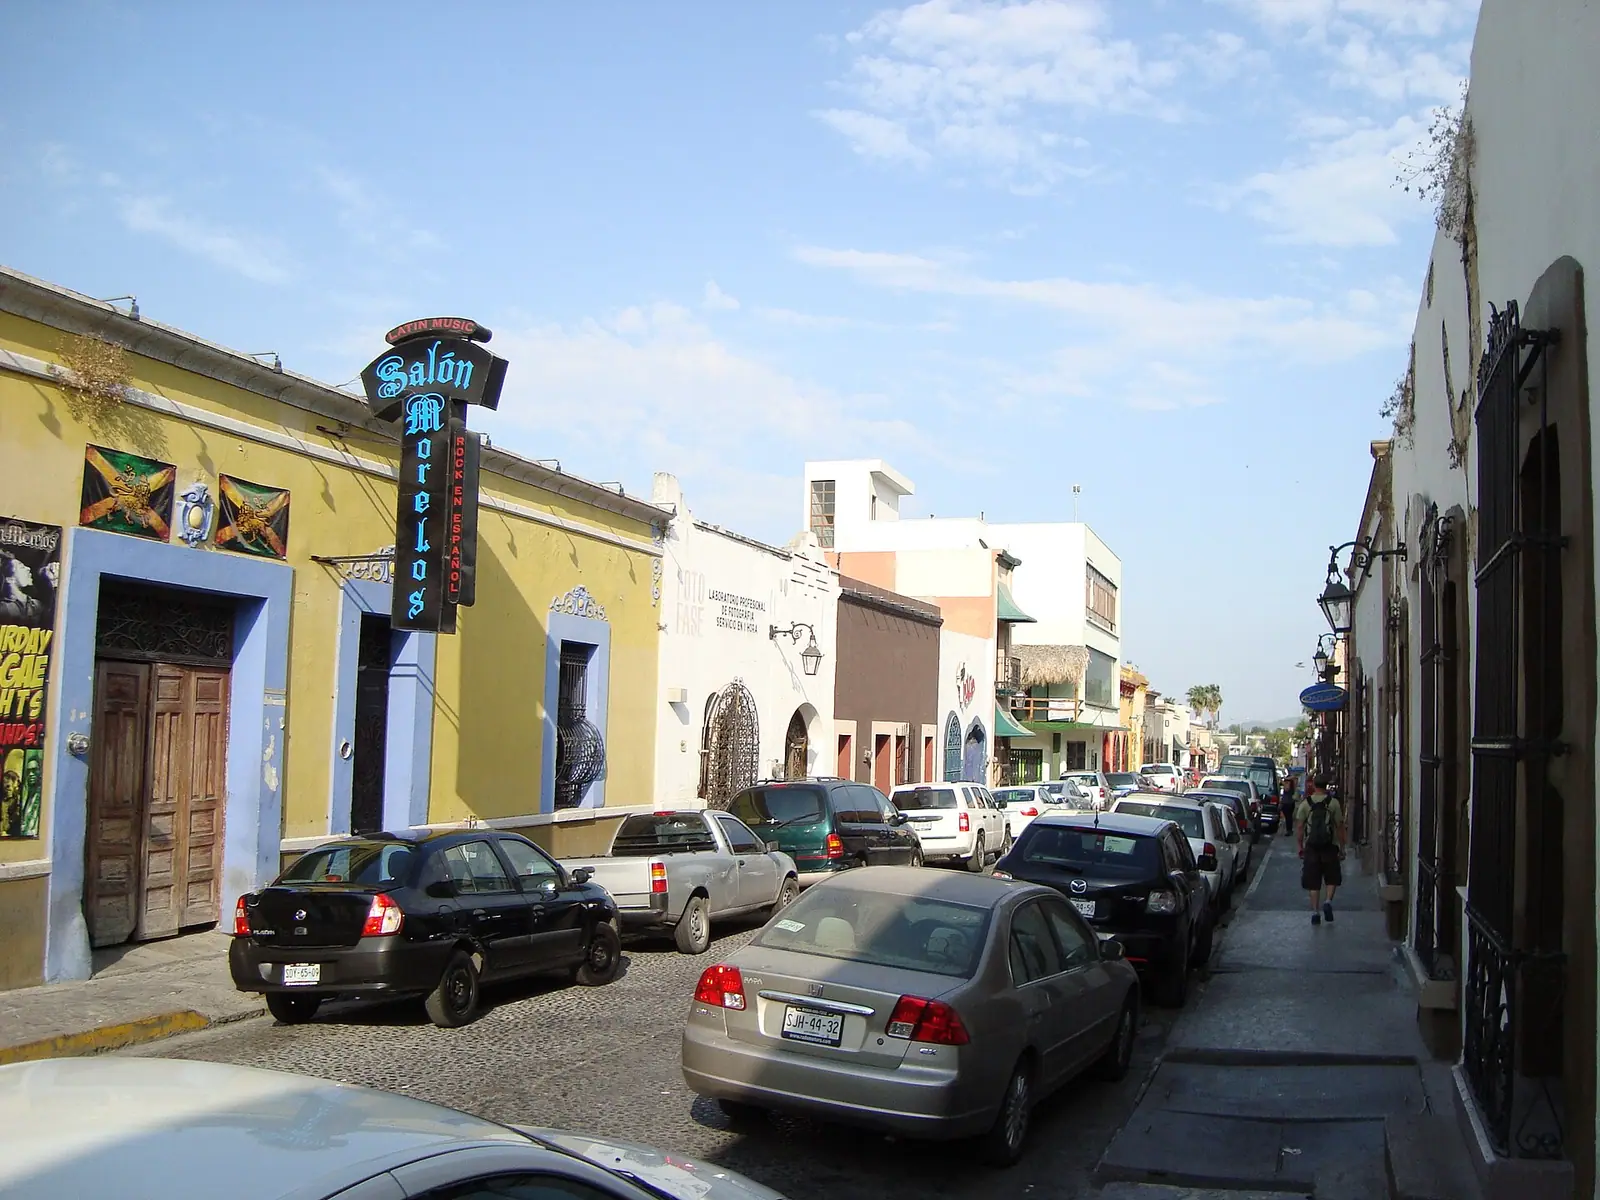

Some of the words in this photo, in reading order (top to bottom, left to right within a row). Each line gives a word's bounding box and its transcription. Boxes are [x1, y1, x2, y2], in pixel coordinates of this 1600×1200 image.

[387, 319, 428, 341] LATIN
[432, 318, 475, 333] MUSIC
[376, 340, 475, 399] Salón
[454, 436, 466, 479] ROCK
[405, 392, 446, 620] Morelos
[453, 486, 463, 506] EN
[450, 514, 462, 593] ESPAÑOL
[786, 1013, 840, 1035] SJH-44-32
